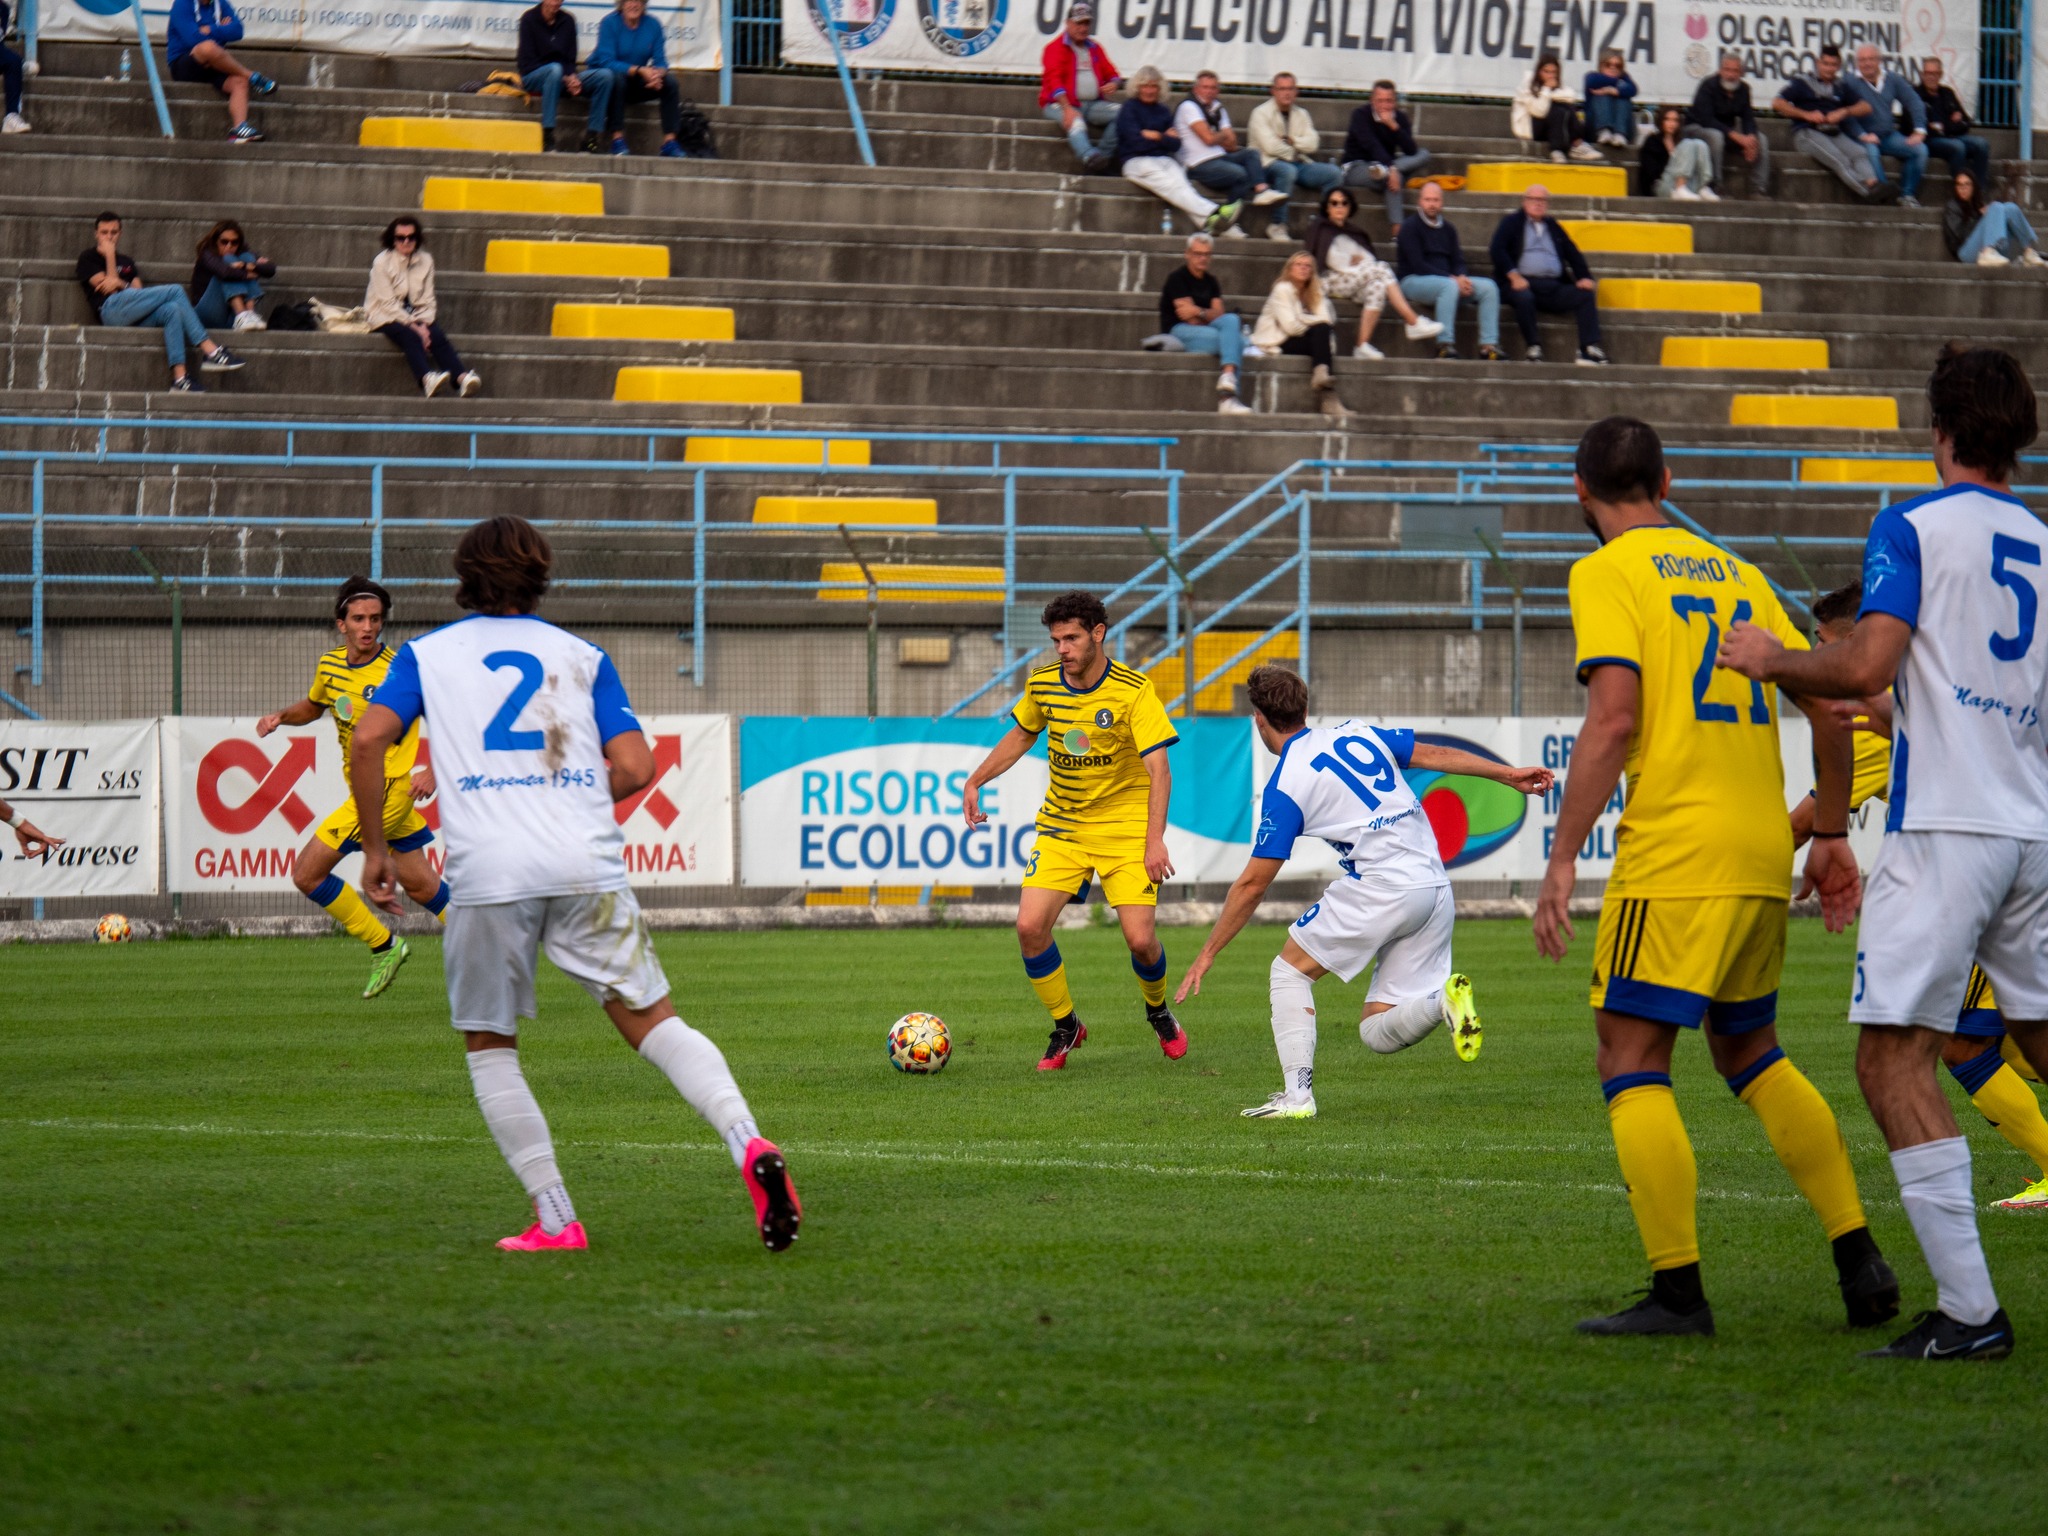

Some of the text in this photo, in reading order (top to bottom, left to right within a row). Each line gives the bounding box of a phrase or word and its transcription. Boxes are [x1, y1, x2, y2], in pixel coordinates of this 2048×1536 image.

[236, 8, 257, 21] OT
[258, 7, 308, 23] ROLLED
[319, 9, 373, 27] FORGED
[384, 13, 418, 28] COLD
[423, 14, 472, 30] DRAWN
[1117, 0, 1289, 46] CALCIO
[1304, 0, 1415, 53] ALLA
[1434, 0, 1656, 64] VIOLENZA
[1718, 13, 1900, 53] OLGA FIORINI
[1651, 554, 1726, 583] ROMANO
[1988, 532, 2041, 662] 5
[482, 650, 545, 751] 2
[0, 747, 143, 791] SIT SAS
[1053, 754, 1112, 767] ECONORD
[1310, 736, 1397, 812] 19
[457, 767, 596, 792] Magenta 1945
[801, 770, 1000, 816] RISORSE
[1368, 809, 1415, 831] Magenta
[41, 842, 140, 868] Varese
[194, 847, 297, 878] GAMM
[800, 823, 1037, 870] ECOLOGIC
[1296, 903, 1320, 928] 9
